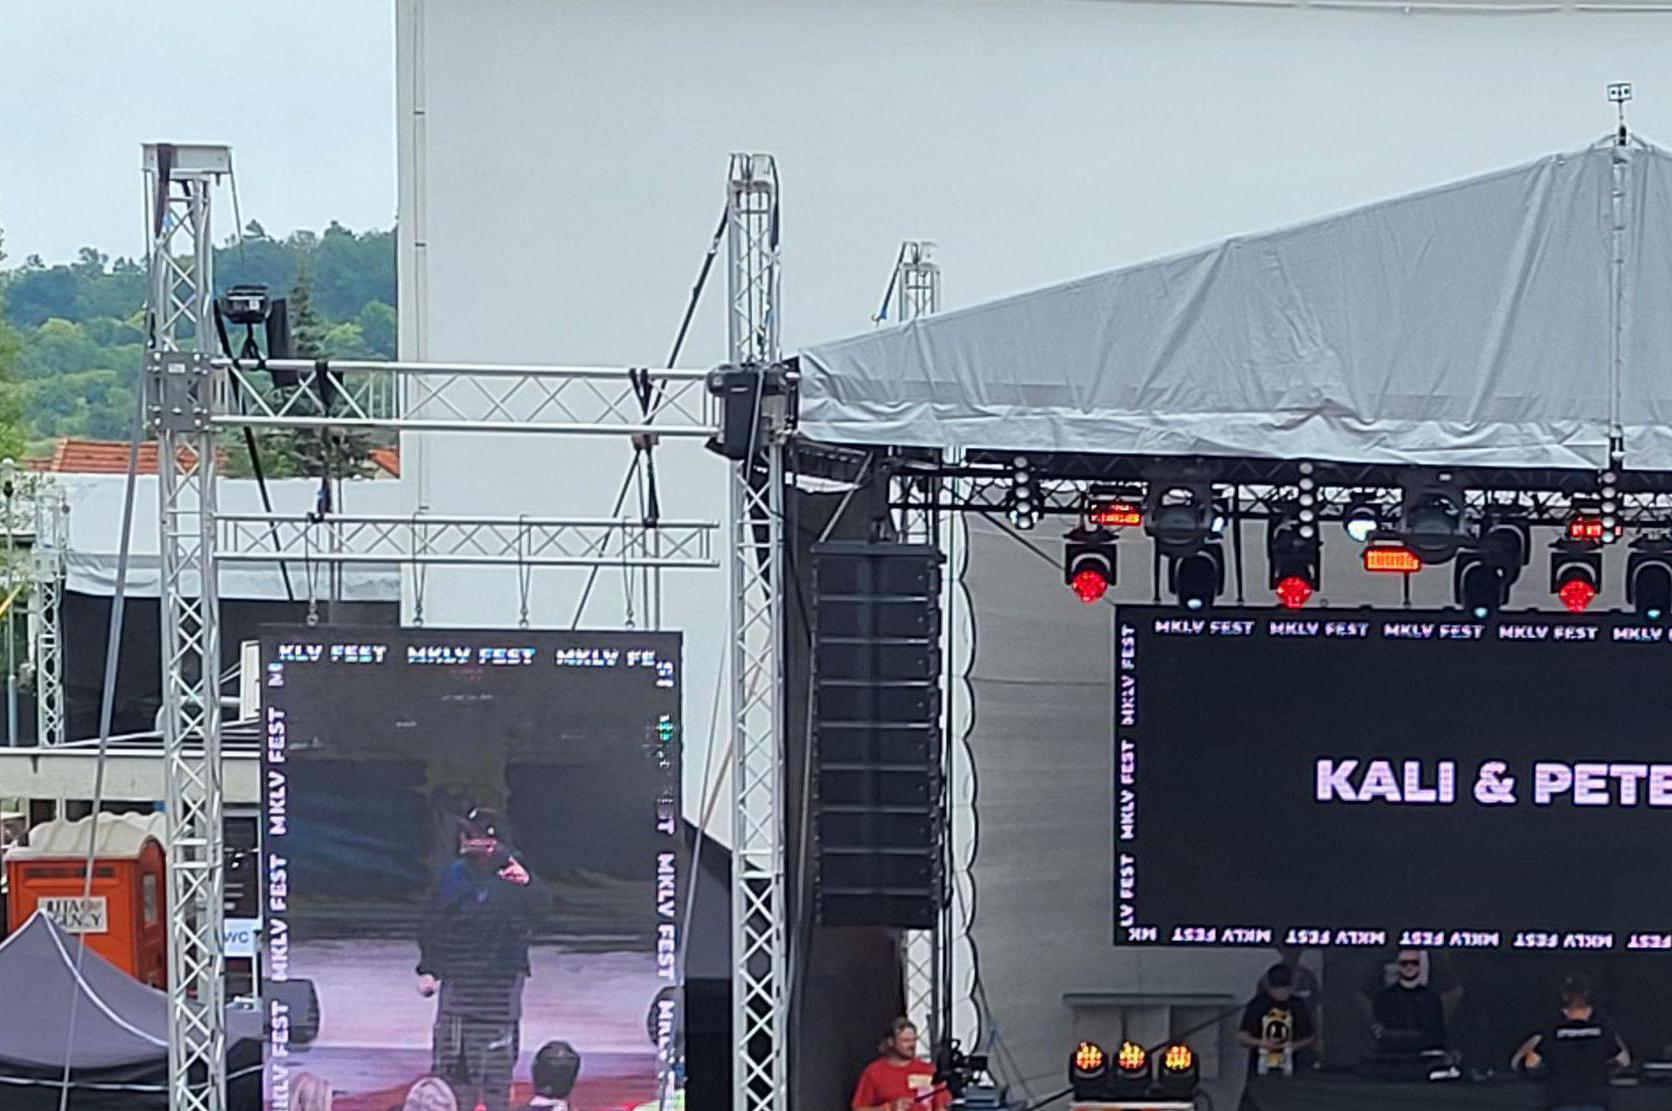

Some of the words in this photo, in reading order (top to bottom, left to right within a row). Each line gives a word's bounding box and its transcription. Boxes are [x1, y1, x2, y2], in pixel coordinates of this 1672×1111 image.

[1121, 625, 1135, 669] FEST
[1154, 621, 1204, 635] MKLV
[1209, 621, 1254, 635] FEST
[1269, 622, 1318, 636] MKLV
[1324, 622, 1368, 636] FEST
[1384, 624, 1433, 638] MKLV
[1439, 624, 1483, 638] FEST
[1499, 626, 1548, 640] MKLV
[1554, 626, 1598, 640] FEST
[1613, 628, 1662, 641] MKLV
[330, 645, 387, 663] FEST
[407, 646, 471, 664] MKLV
[478, 648, 536, 665] FEST
[556, 648, 619, 666] MKLV
[268, 707, 286, 762] FEST
[1120, 740, 1135, 784] FEST
[1317, 759, 1454, 803] KALI
[1473, 761, 1516, 804] &
[269, 772, 286, 835] MKLV
[1120, 790, 1135, 840] MKLV
[270, 855, 287, 910] FEST
[658, 854, 675, 917] MKLV
[1119, 855, 1135, 899] FEST
[270, 919, 288, 981] MKLV
[1172, 928, 1215, 942] FEST
[1222, 928, 1271, 942] MKLV
[1286, 930, 1330, 944] FEST
[1336, 930, 1385, 944] MKLV
[1400, 932, 1444, 946] FEST
[1450, 932, 1498, 946] MKLV
[1514, 933, 1558, 947] FEST
[1564, 933, 1613, 947] MKLV
[1628, 935, 1671, 949] FEST
[658, 924, 675, 981] FEST
